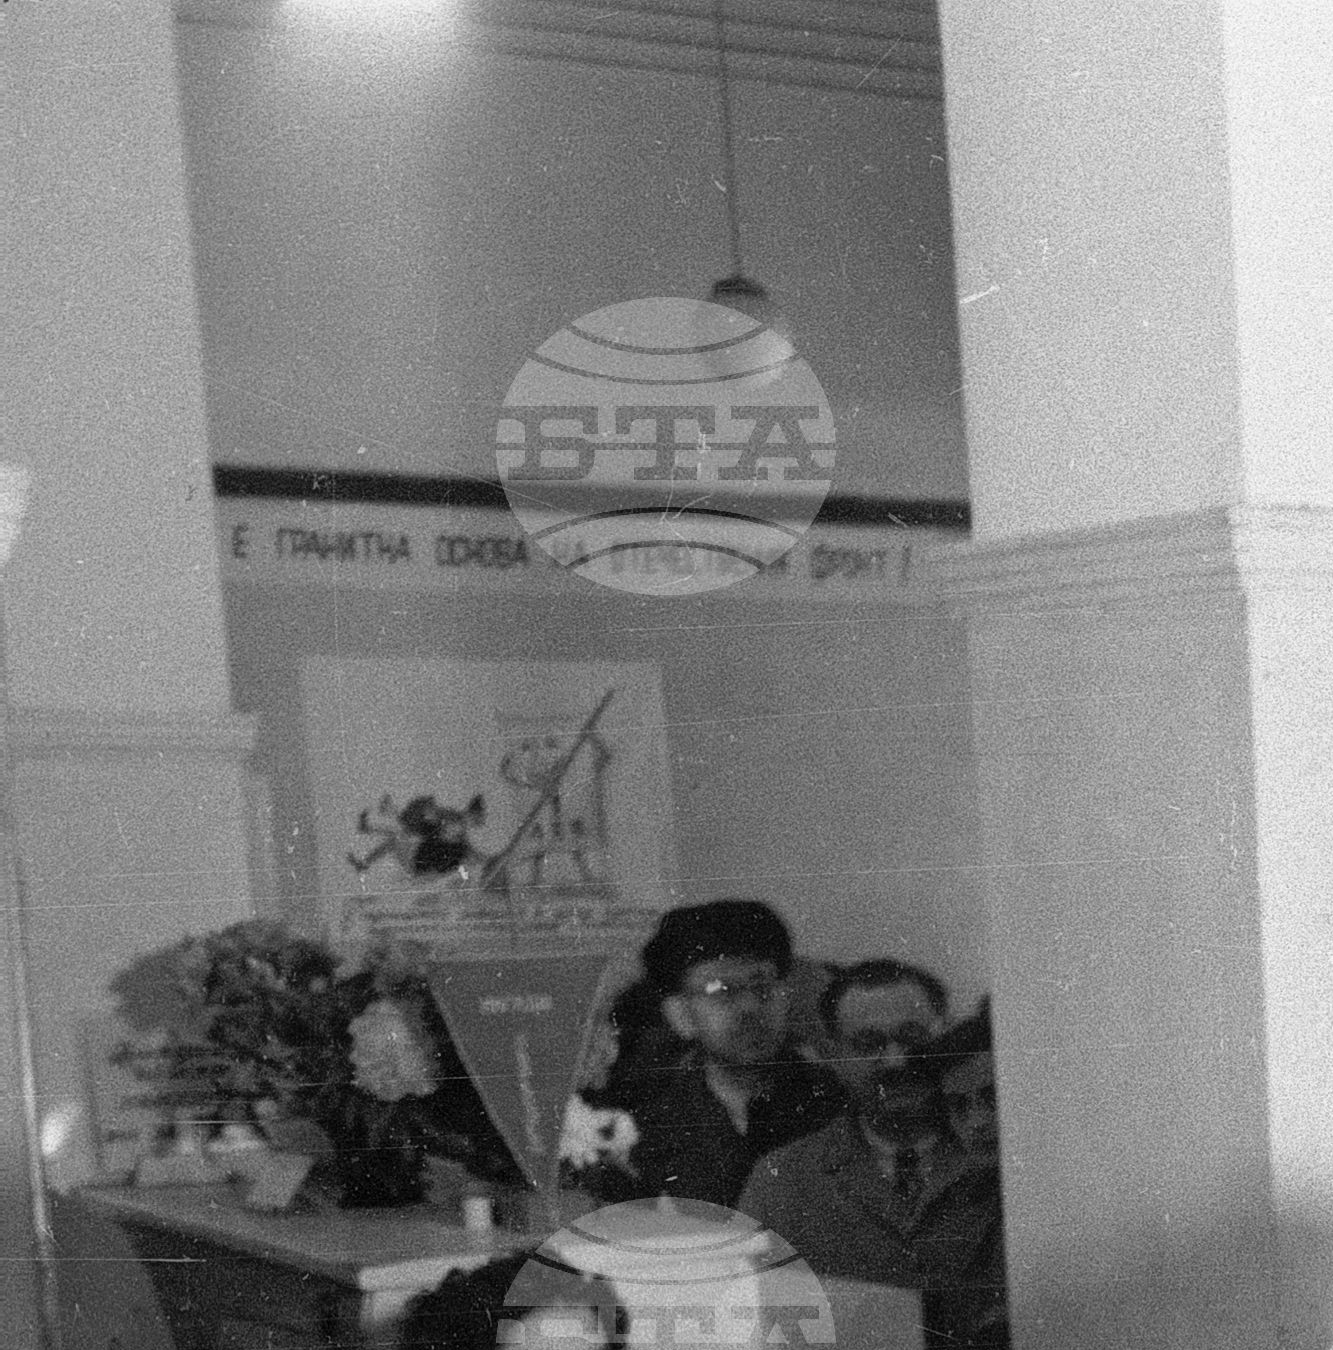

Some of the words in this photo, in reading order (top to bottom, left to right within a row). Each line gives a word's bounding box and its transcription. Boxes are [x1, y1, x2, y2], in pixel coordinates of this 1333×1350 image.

[231, 522, 249, 559] Е
[273, 527, 412, 565] ГРАНИТНА
[435, 533, 530, 568] ОСНОВА
